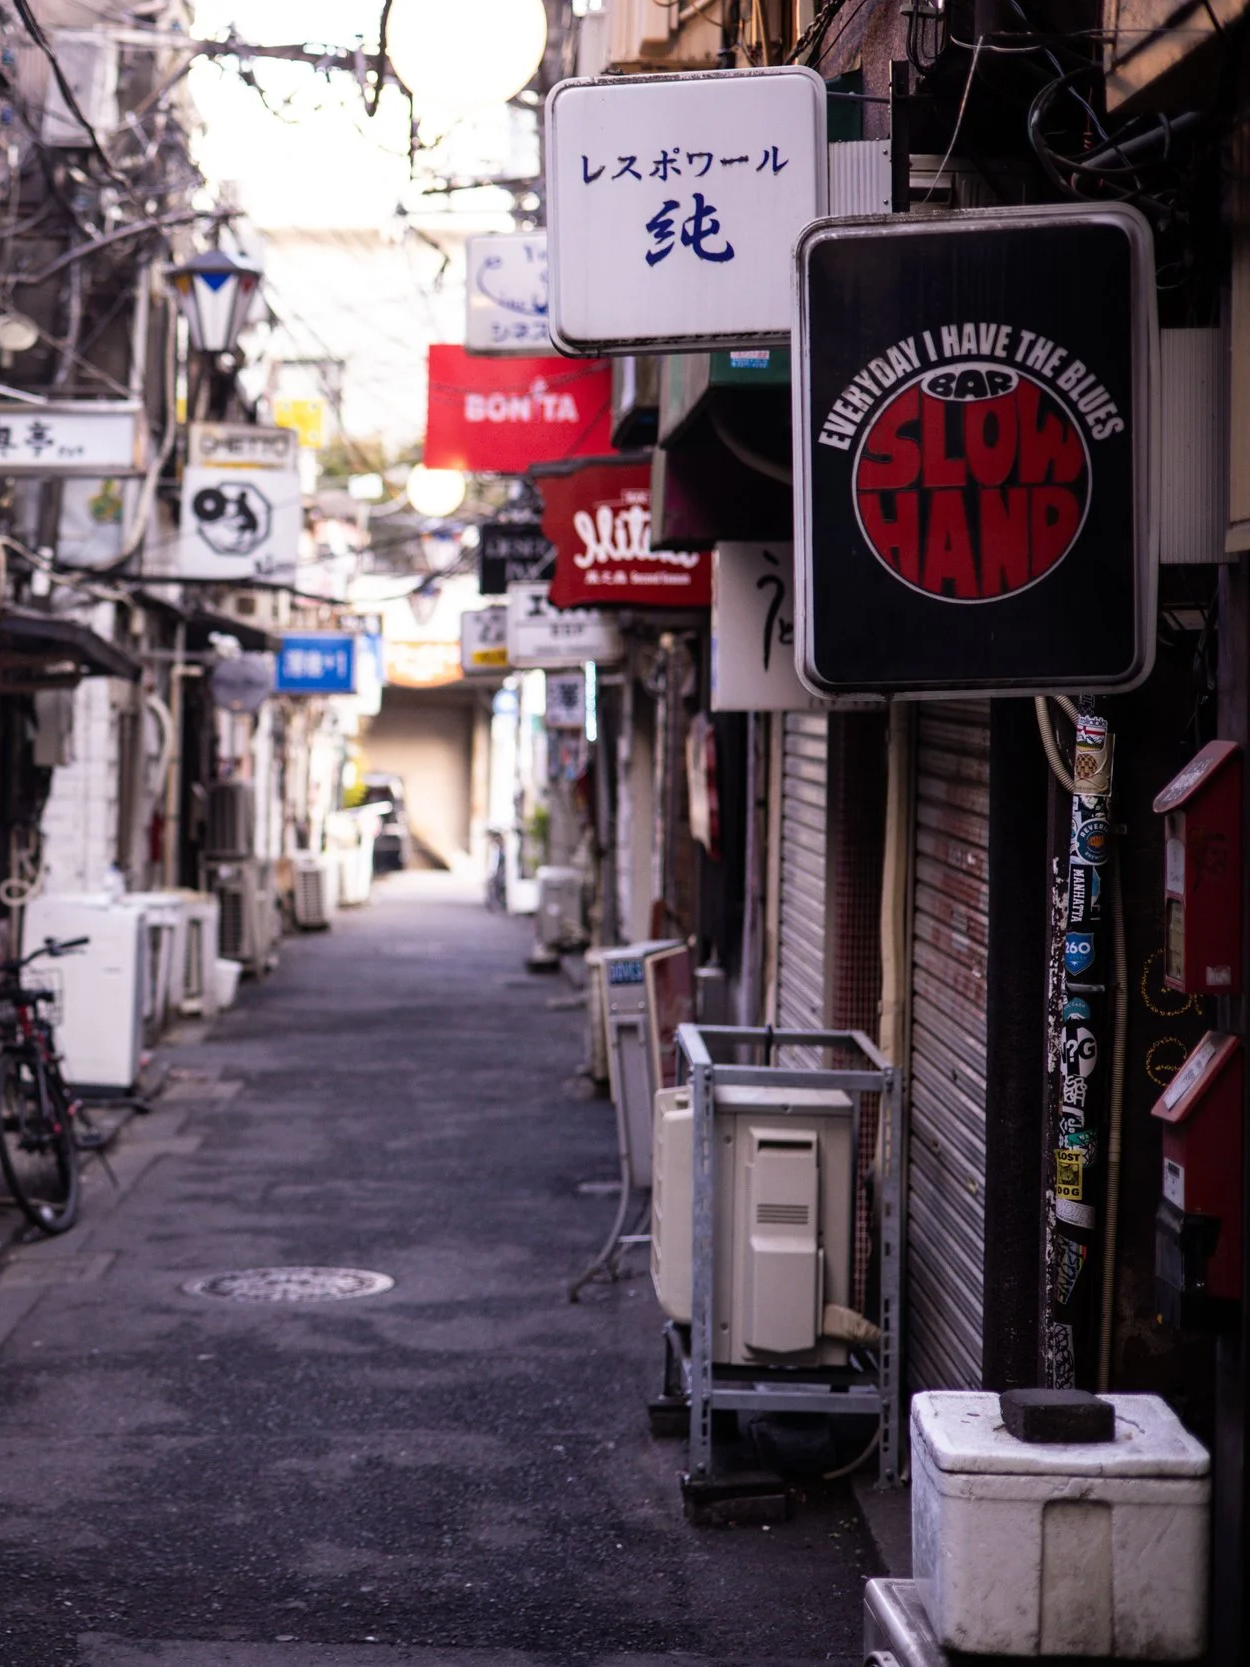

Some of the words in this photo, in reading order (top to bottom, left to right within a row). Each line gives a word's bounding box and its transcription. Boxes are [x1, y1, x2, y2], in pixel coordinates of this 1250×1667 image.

[581, 145, 790, 184] レスポワール
[644, 192, 735, 267] 純
[818, 336, 923, 451] EVERYDAY
[922, 329, 938, 362] I
[940, 322, 1014, 359] HAVE
[1014, 329, 1070, 379] THE
[1054, 359, 1126, 442] BLUES
[927, 369, 1014, 399] BAR
[857, 376, 1085, 490] SLOW
[857, 485, 1080, 600] HAND
[1058, 1152, 1081, 1161] LOST
[1058, 1186, 1080, 1196] DOG
